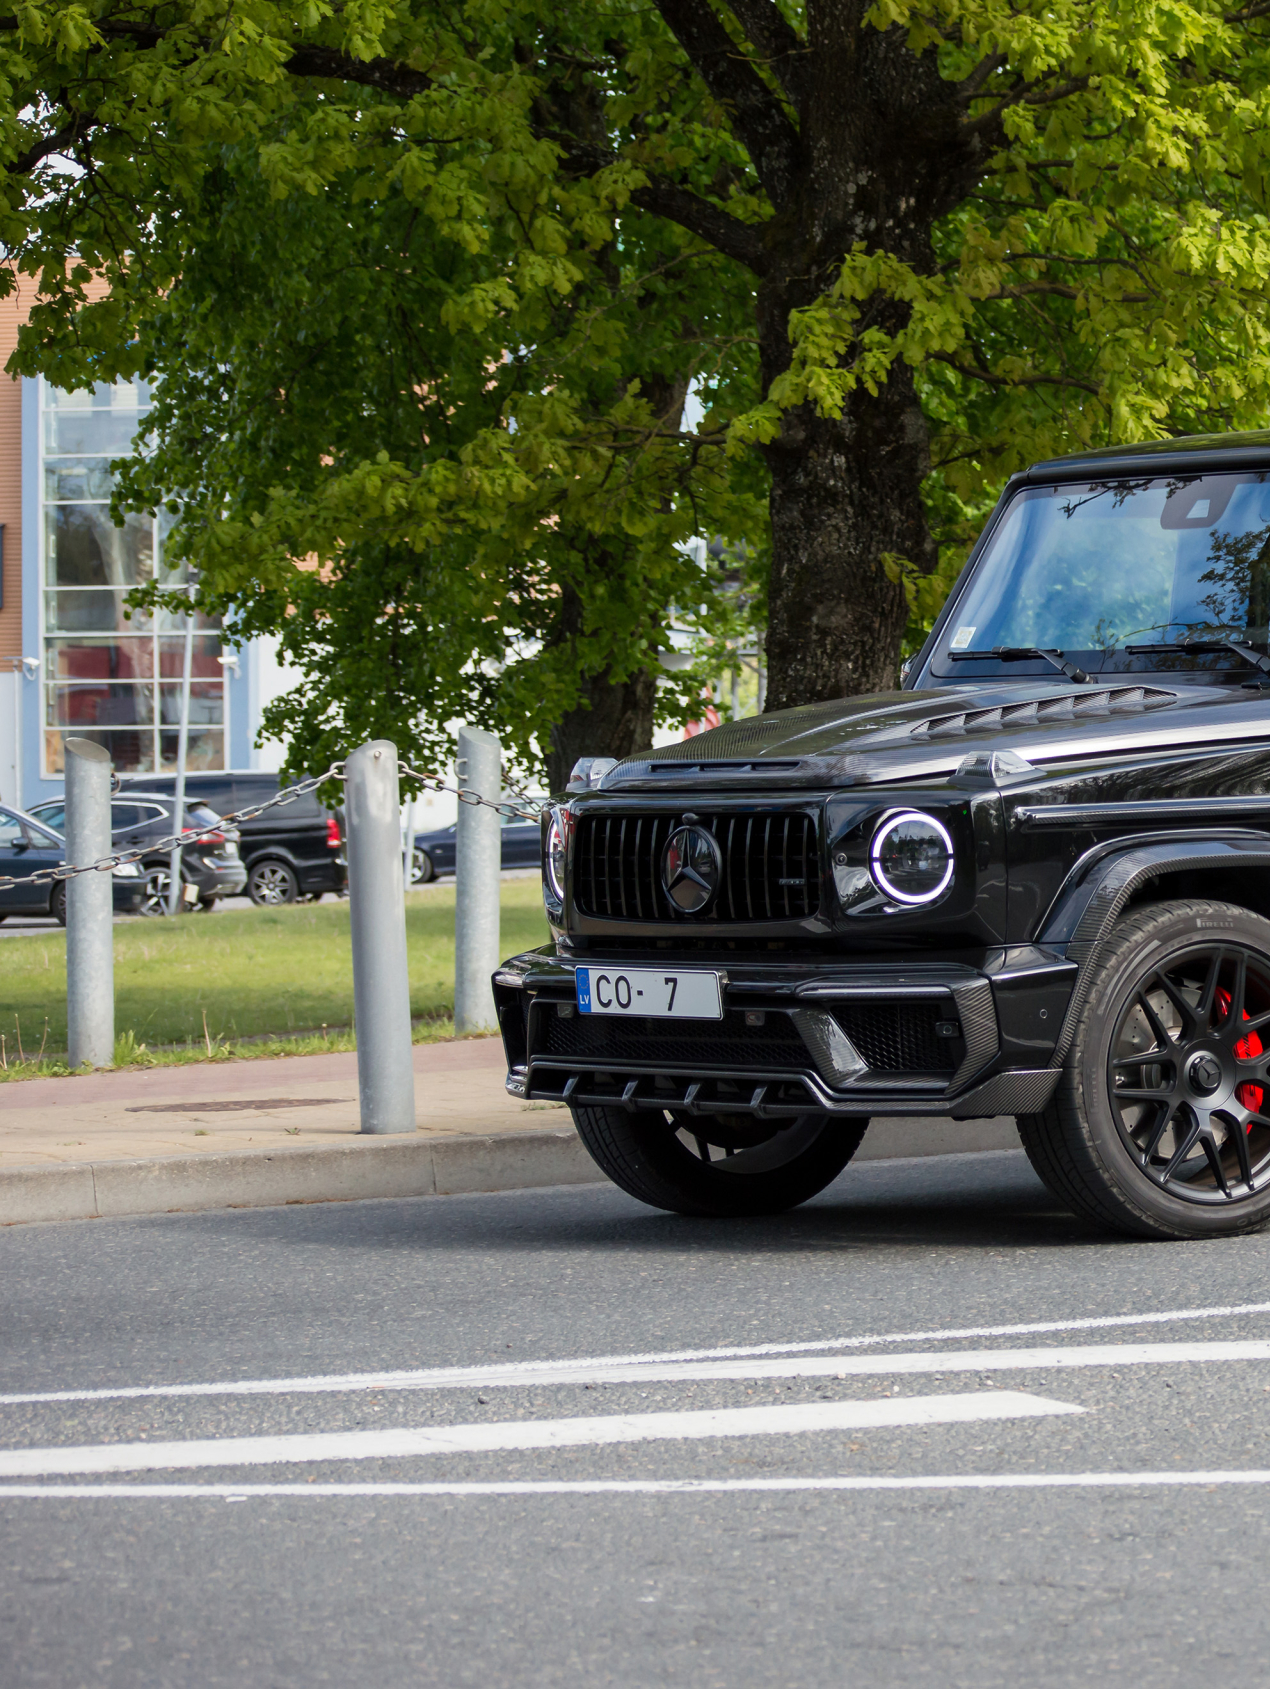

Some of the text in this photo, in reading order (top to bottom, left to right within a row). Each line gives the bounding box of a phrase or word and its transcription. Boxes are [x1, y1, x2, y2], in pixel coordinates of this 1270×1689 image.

[1196, 918, 1234, 928] PIRELLI
[664, 977, 678, 1011] 7
[579, 995, 590, 1004] LV
